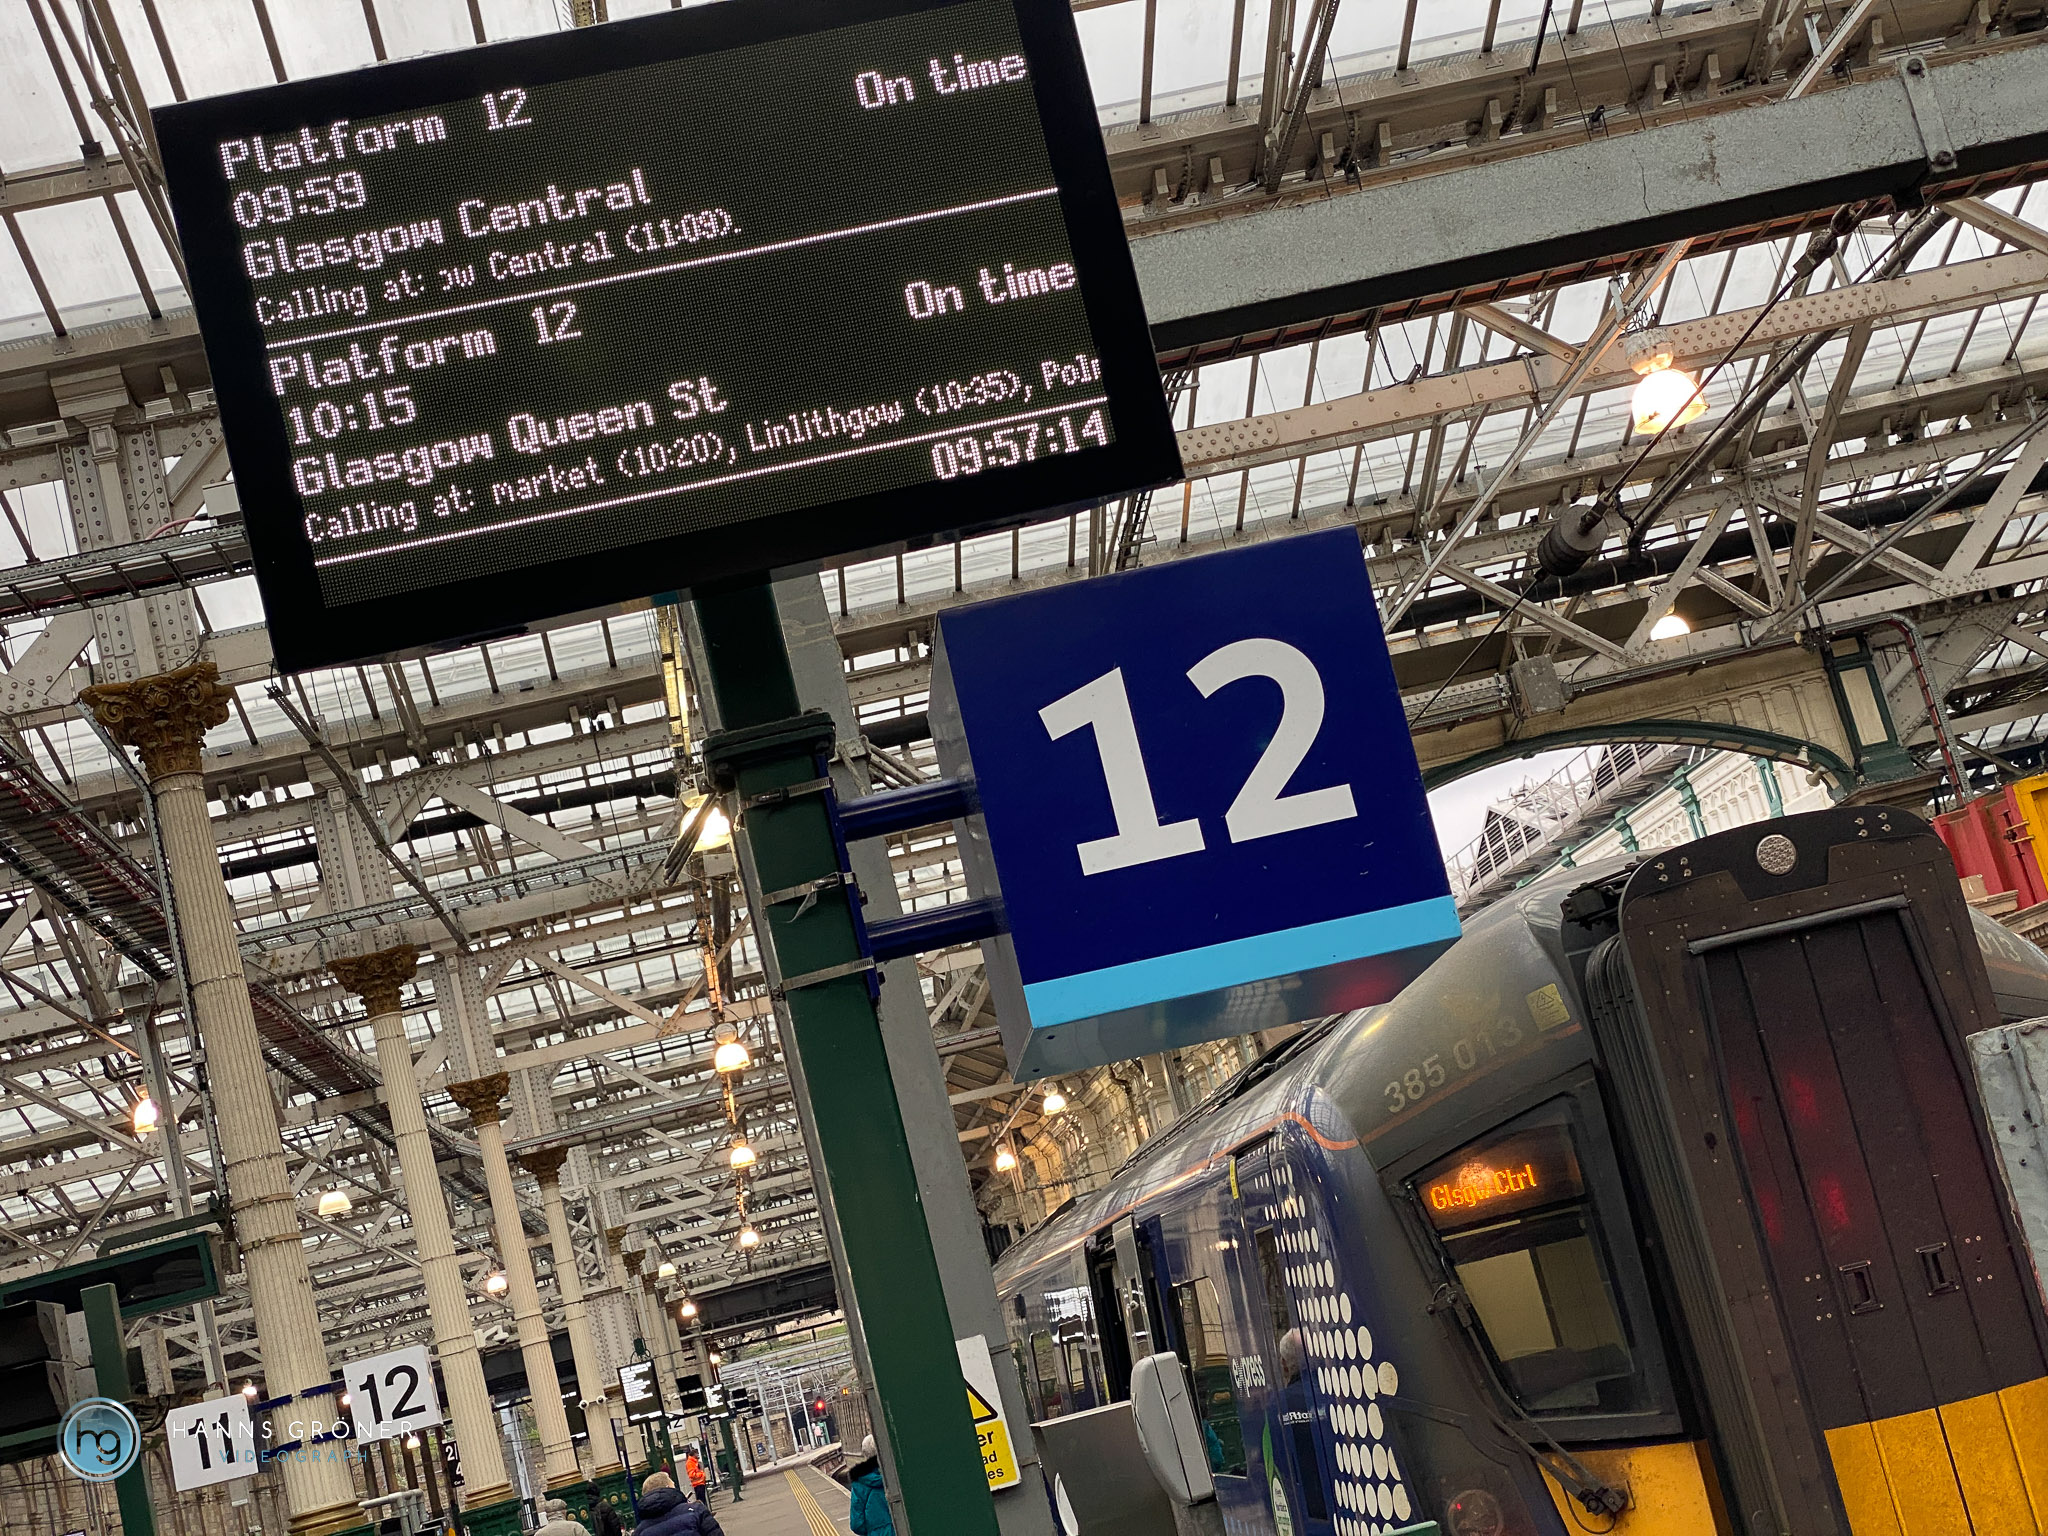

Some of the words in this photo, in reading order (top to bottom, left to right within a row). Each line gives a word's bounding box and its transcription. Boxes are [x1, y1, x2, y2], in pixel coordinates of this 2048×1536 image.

[855, 70, 915, 109] On
[928, 54, 1027, 95] time
[219, 115, 447, 180] Platform
[481, 88, 532, 131] 12
[232, 170, 367, 229] 09:59
[243, 218, 444, 280] Glasgow
[458, 168, 651, 238] Central
[255, 284, 369, 326] Calling
[383, 269, 425, 302] at:
[488, 230, 615, 281] Central
[624, 208, 742, 253] (11:09).
[904, 280, 964, 320] On
[978, 262, 1076, 304] time
[268, 329, 496, 396] Platform
[531, 300, 582, 345] 12
[288, 385, 416, 445] 10:15
[292, 433, 494, 496] Glasgow
[507, 401, 655, 454] Queen
[667, 376, 728, 420] St
[931, 409, 1108, 480] 09:57:14
[304, 500, 418, 543] Calling
[433, 484, 475, 517] at:
[491, 456, 605, 505] market
[617, 431, 736, 478] (10:20),
[746, 400, 905, 452] Linlithgow
[915, 369, 1033, 416] (10:35),
[1038, 637, 1358, 877] 12
[1384, 1053, 1446, 1113] 385
[1453, 1016, 1523, 1070] 013
[1430, 1184, 1490, 1210] Glsgw
[1493, 1164, 1537, 1195] Ctrl
[358, 1364, 427, 1425] 12
[188, 1411, 238, 1470] 11
